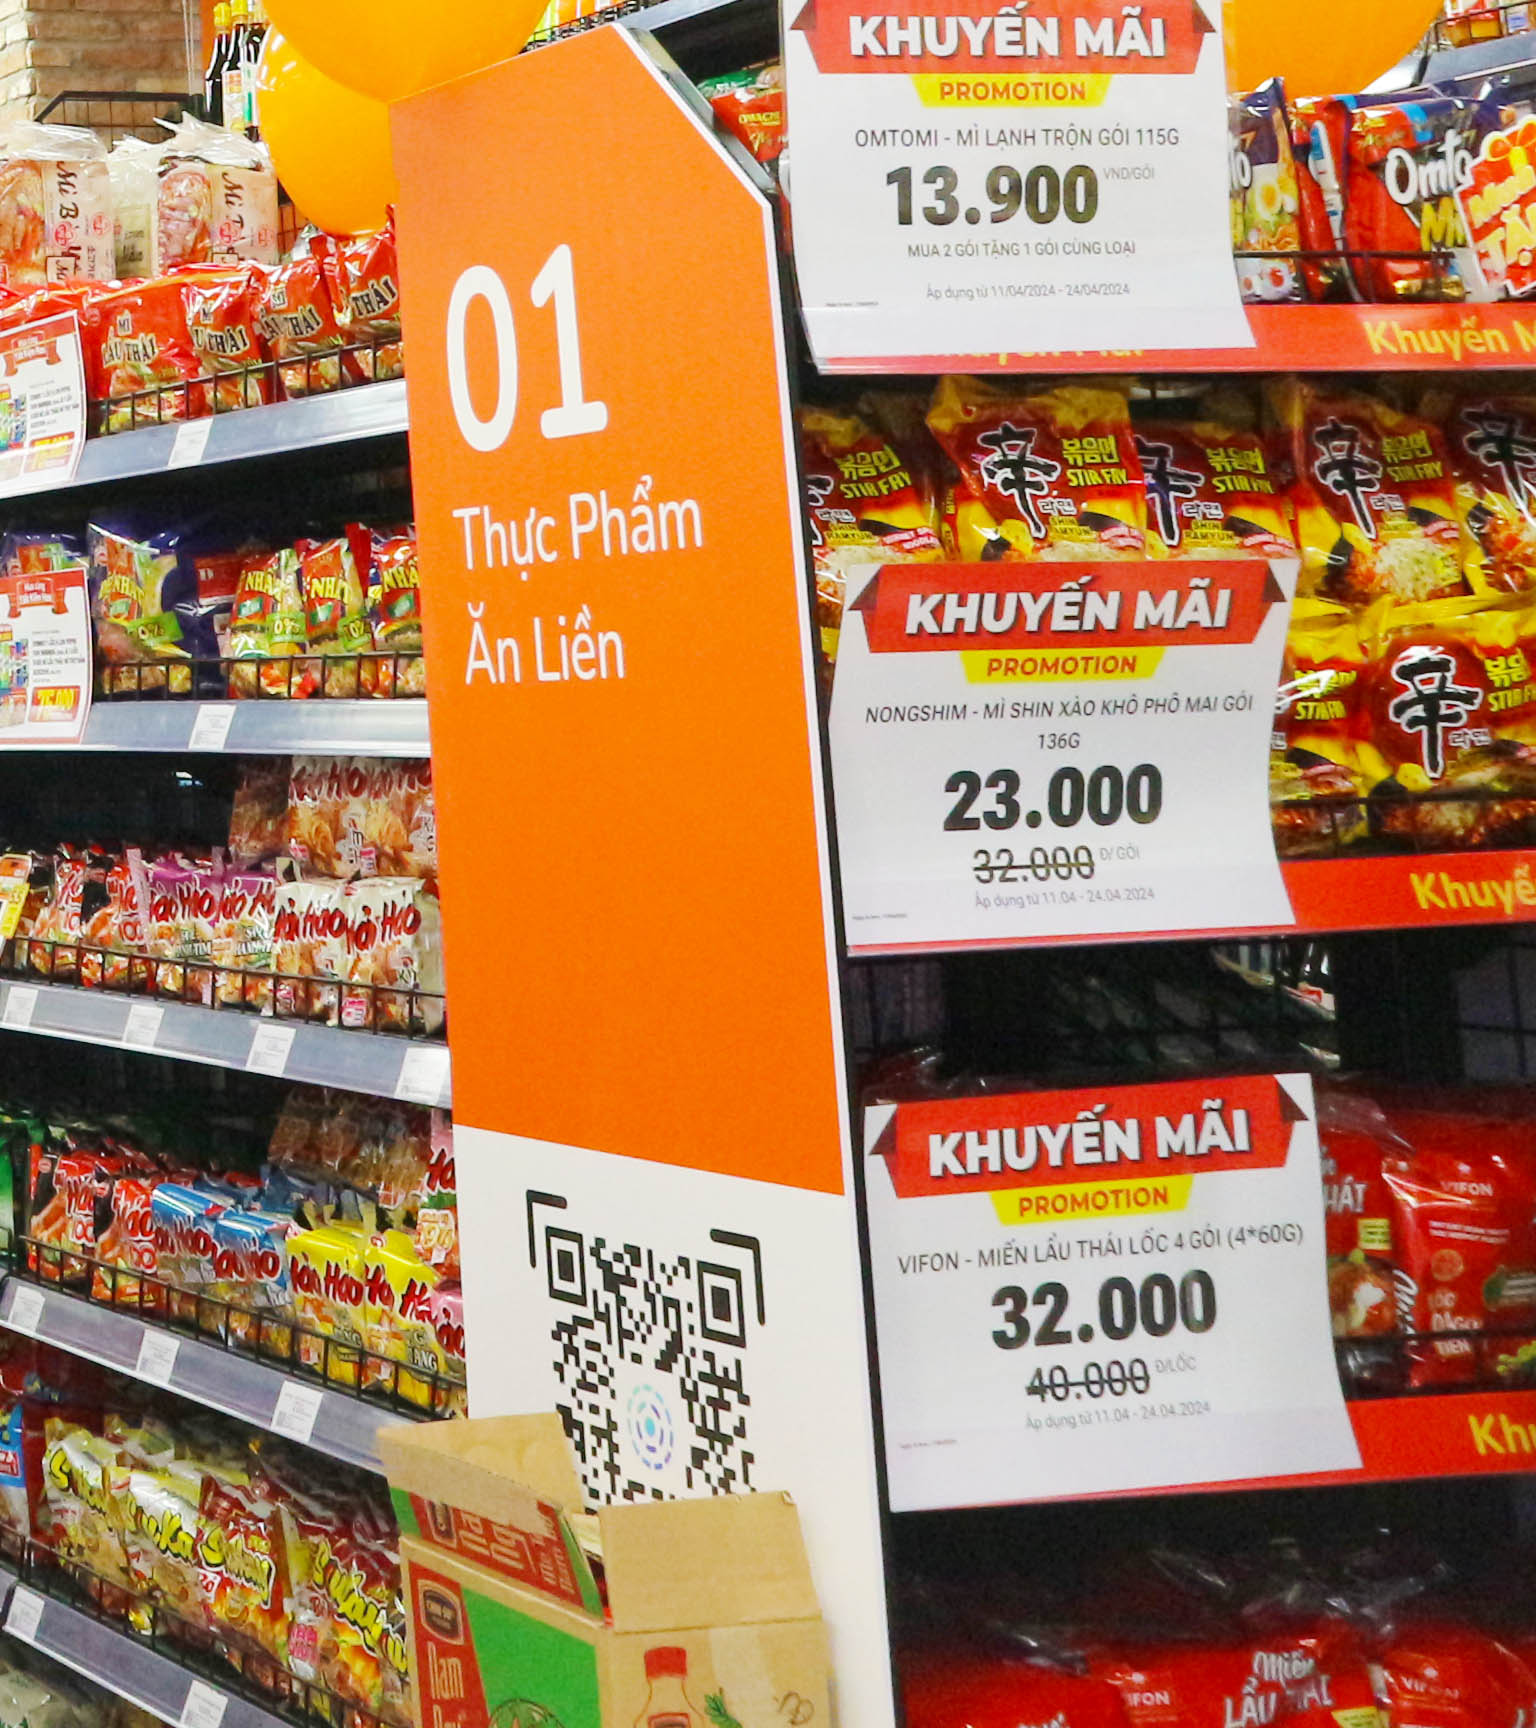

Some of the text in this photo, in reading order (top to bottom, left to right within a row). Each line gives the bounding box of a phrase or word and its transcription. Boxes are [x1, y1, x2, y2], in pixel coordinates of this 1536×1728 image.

[848, 3, 1166, 58] KHUYẾN MÃI
[939, 82, 1086, 101] PROMOTION
[855, 123, 1179, 151] OMTOMI MÌ LẠNH TRỘN GÓI 115G
[885, 164, 1099, 226] 13.900
[908, 238, 1135, 260] MUA 2 GÓI TẶNG 1 GÓI CÙNG LOẠI
[446, 243, 609, 452] 01
[1362, 315, 1509, 361] Khuyến
[453, 475, 704, 581] Thực Phẩm
[905, 574, 1233, 635] KHUYẾN MÃI
[465, 601, 625, 685] Ăn Liền
[987, 656, 1137, 676] PROMOTION
[865, 691, 1254, 723] NONGSHIM MÌ SHIN XÀO KHÔ PHÔ MAI GÓI
[1037, 732, 1080, 750] 136G
[943, 763, 1163, 832] 23.000
[972, 845, 1095, 885] 32.000
[927, 1099, 1250, 1177] KHUYẾN MÃI
[1019, 1186, 1169, 1217] PROMOTION
[899, 1248, 959, 1274] VIFON
[1033, 1232, 1070, 1263] LẨU
[1078, 1232, 1123, 1259] THÁI
[1174, 1230, 1184, 1249] 4
[1189, 1223, 1222, 1250] GÓI
[991, 1270, 1217, 1350] 32.000
[1026, 1358, 1150, 1403] 40.000
